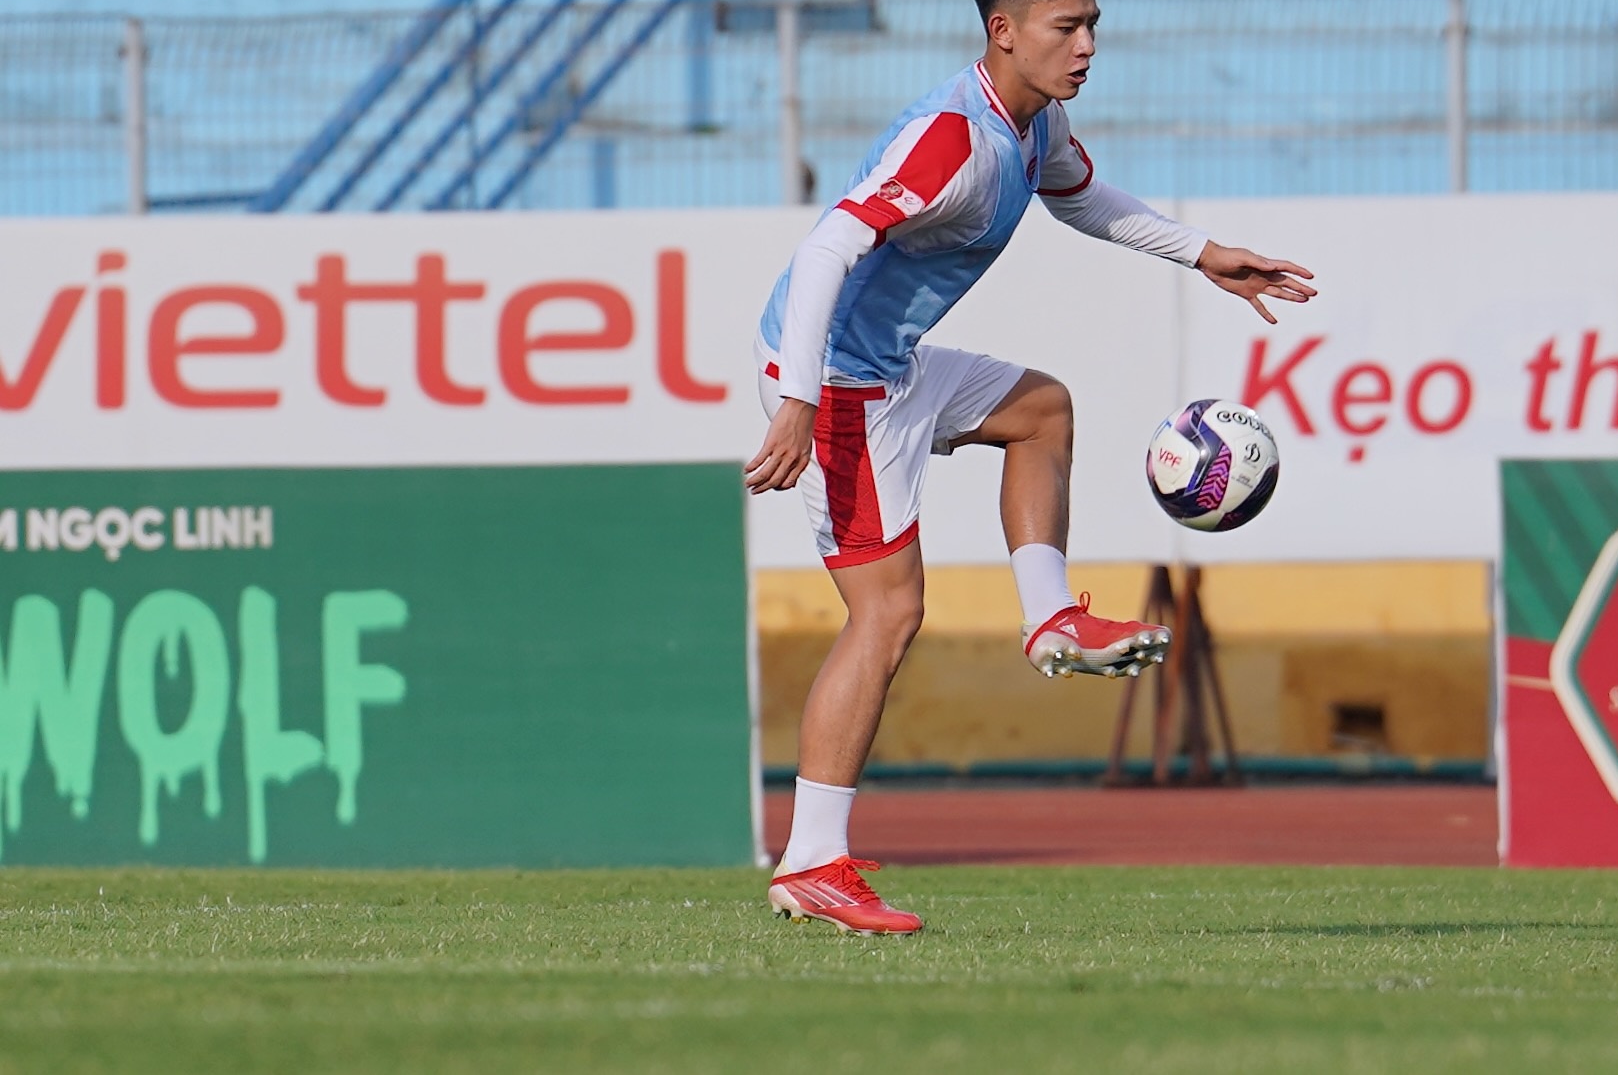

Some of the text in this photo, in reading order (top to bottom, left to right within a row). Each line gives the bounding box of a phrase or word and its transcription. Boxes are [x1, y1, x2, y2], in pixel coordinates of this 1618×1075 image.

[0, 249, 728, 411] viettel
[1158, 447, 1183, 467] VPF
[1240, 335, 1475, 463] Kẹo
[26, 506, 165, 562] NGỌC
[172, 505, 273, 550] LINH
[0, 586, 409, 863] WOLF
